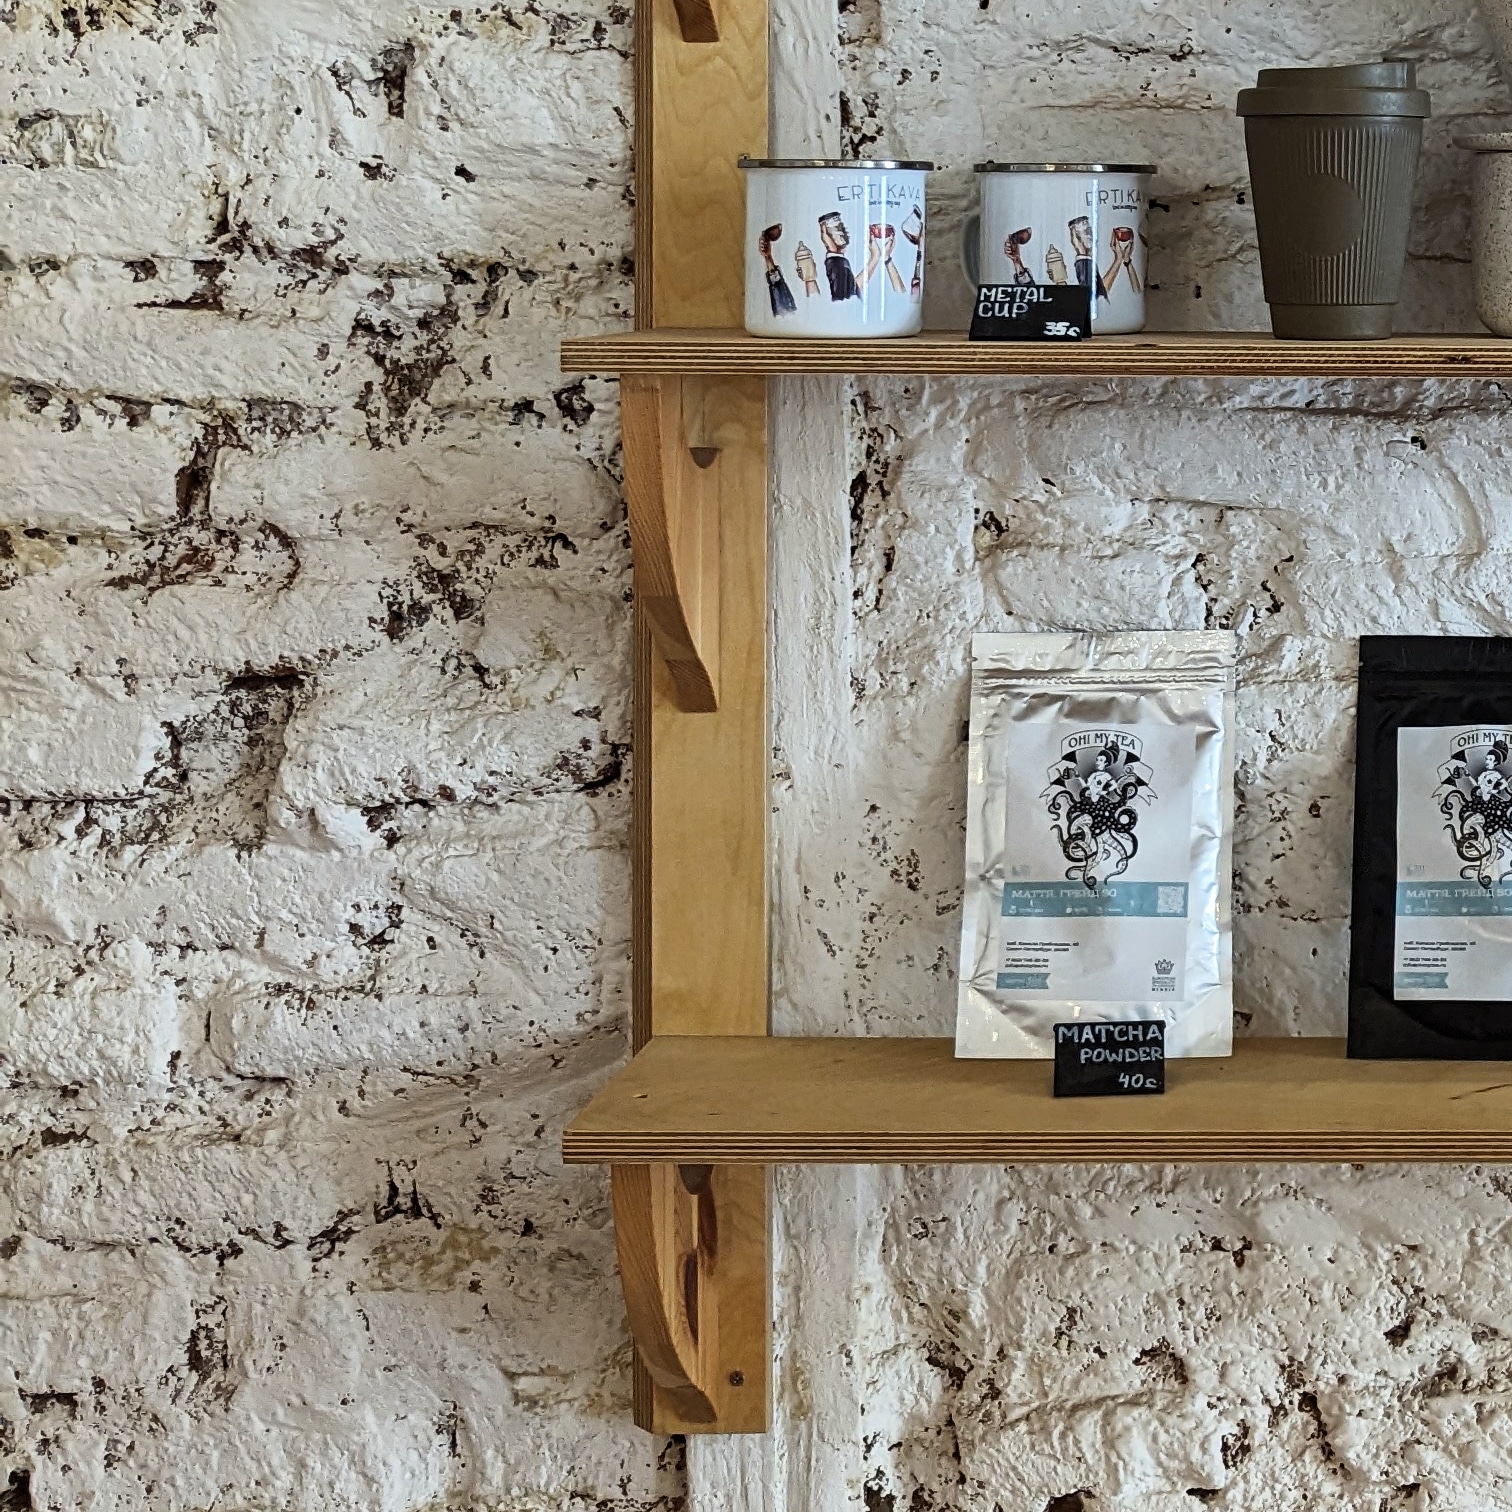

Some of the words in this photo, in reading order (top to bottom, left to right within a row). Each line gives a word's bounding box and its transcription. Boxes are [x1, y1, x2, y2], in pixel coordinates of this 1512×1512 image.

[979, 286, 1053, 303] METAL
[978, 302, 1029, 318] CUP
[1094, 732, 1111, 748] MY
[1113, 733, 1136, 750] TEA
[1482, 732, 1499, 743] MY
[1058, 1024, 1163, 1044] MATCHA
[1079, 1046, 1164, 1064] POWDER
